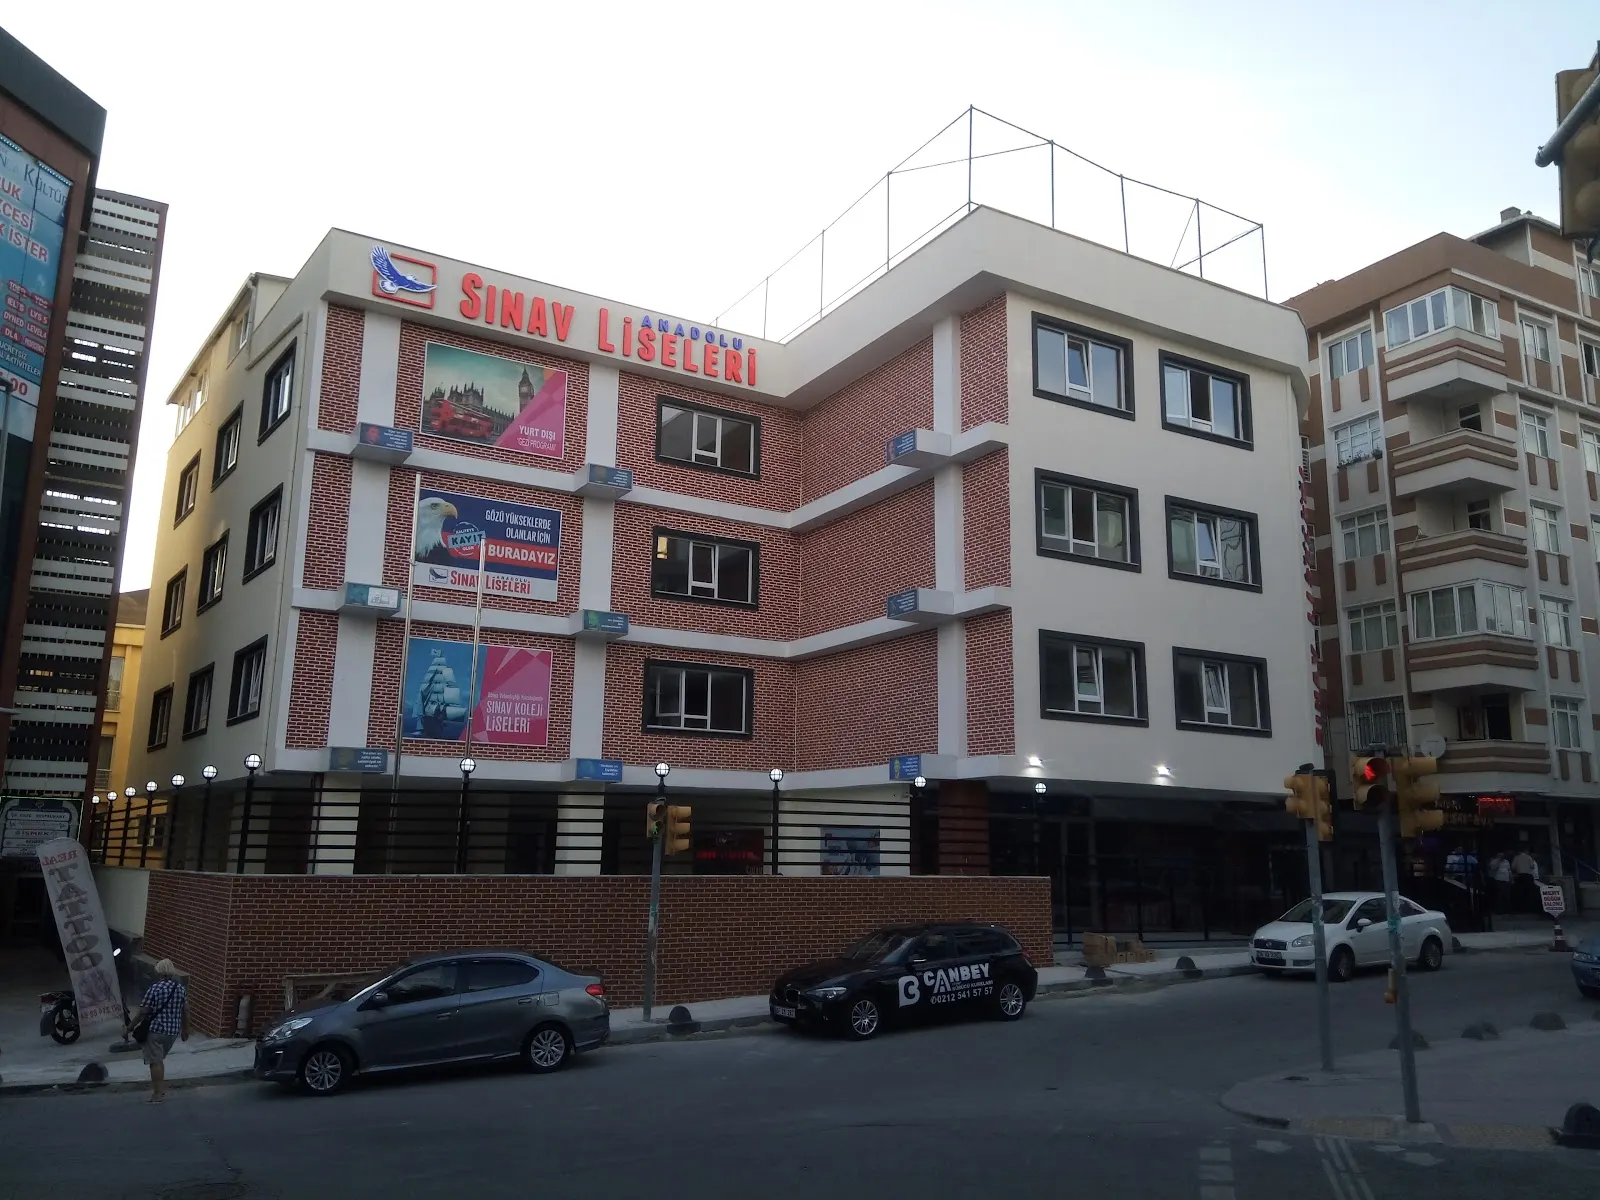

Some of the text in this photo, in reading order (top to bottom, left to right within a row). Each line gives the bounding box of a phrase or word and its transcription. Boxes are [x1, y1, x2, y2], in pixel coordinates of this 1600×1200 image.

[8, 225, 48, 262] İSTER
[4, 328, 19, 340] DLA
[460, 272, 756, 386] SINAV LİSELERİ
[642, 314, 744, 350] ANADOLU
[519, 425, 556, 440] YURT DIŞI
[486, 510, 552, 530] GÖZÜ YÜKSEKLERDE
[451, 533, 484, 545] KAYIT
[506, 527, 551, 545] OLANLAR İÇİN
[488, 544, 556, 565] BURADAYIZ
[450, 570, 531, 594] SINA LİSELERİ
[487, 700, 543, 718] SINAV KOLEJİ
[486, 716, 530, 734] LİSELERİ
[923, 962, 990, 994] CANBEY
[936, 986, 993, 1003] 0212 541 57 57
